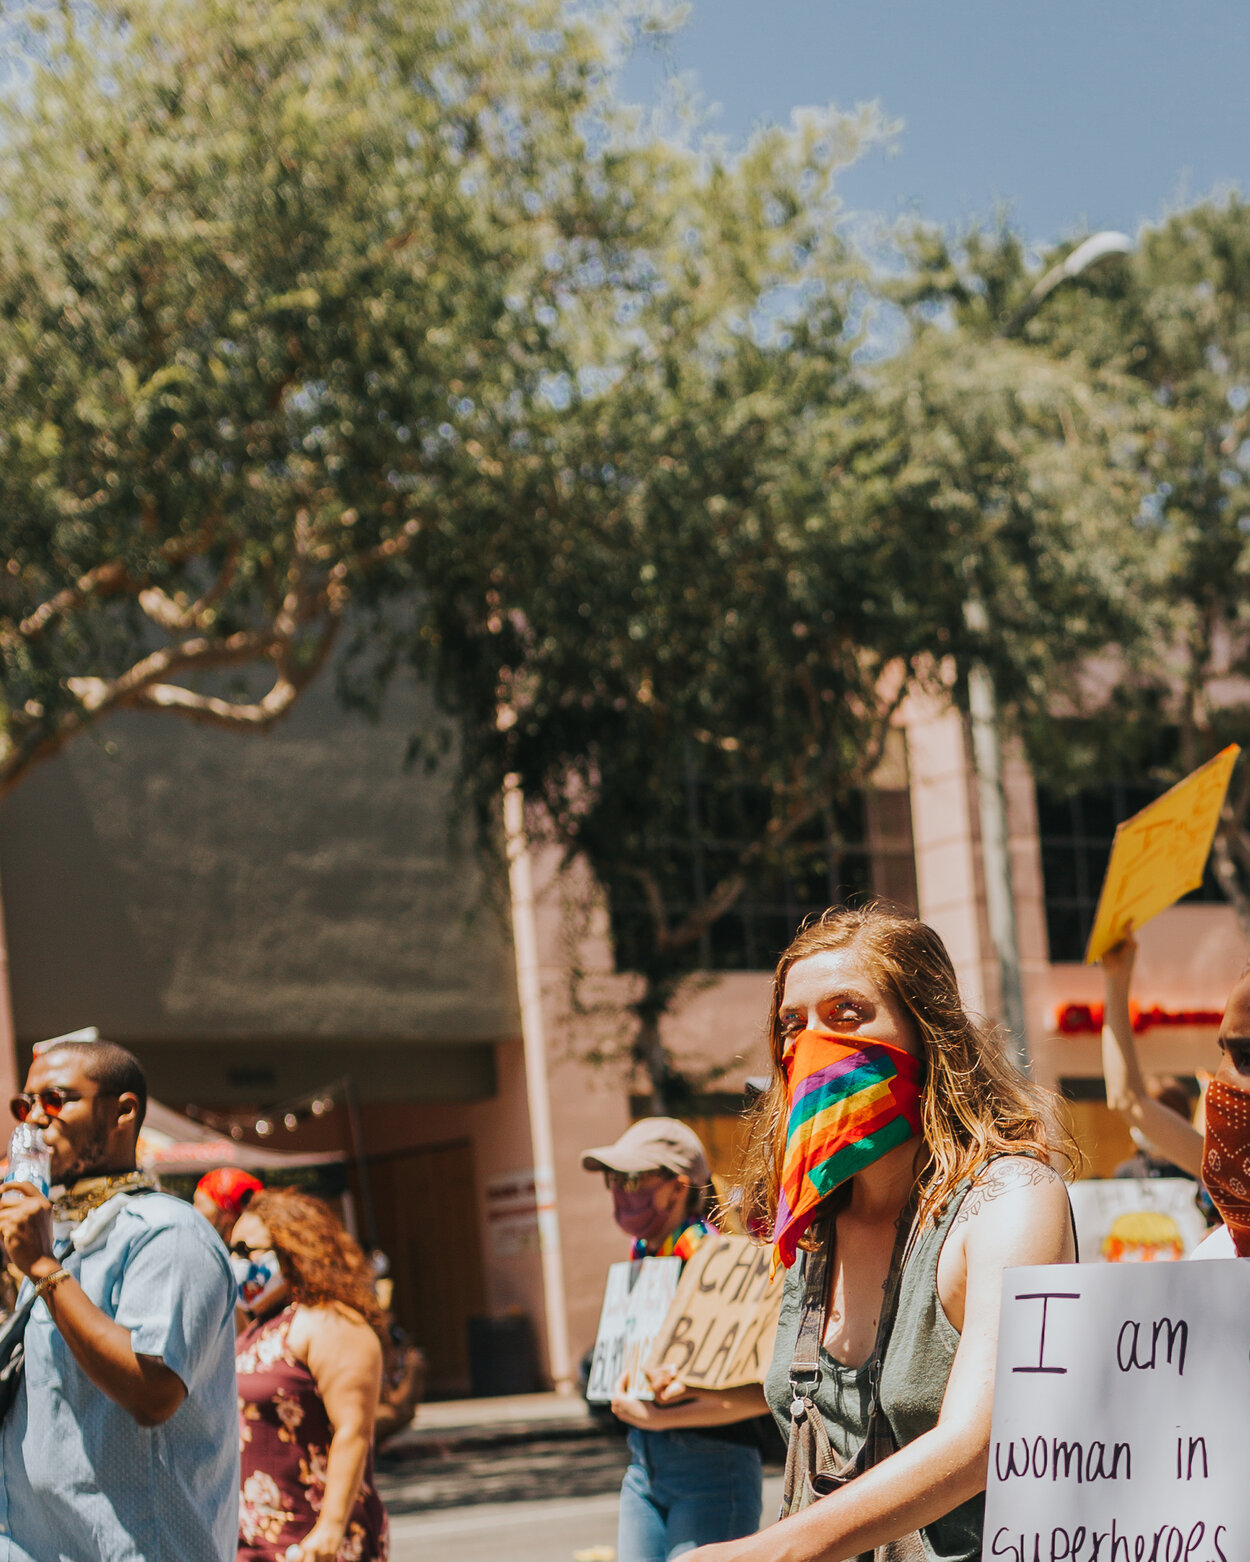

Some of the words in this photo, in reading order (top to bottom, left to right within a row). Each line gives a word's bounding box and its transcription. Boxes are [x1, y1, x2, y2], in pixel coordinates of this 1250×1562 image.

[1012, 1293, 1080, 1374] I
[1117, 1317, 1188, 1376] am
[996, 1434, 1132, 1484] woman
[1176, 1425, 1209, 1480] in
